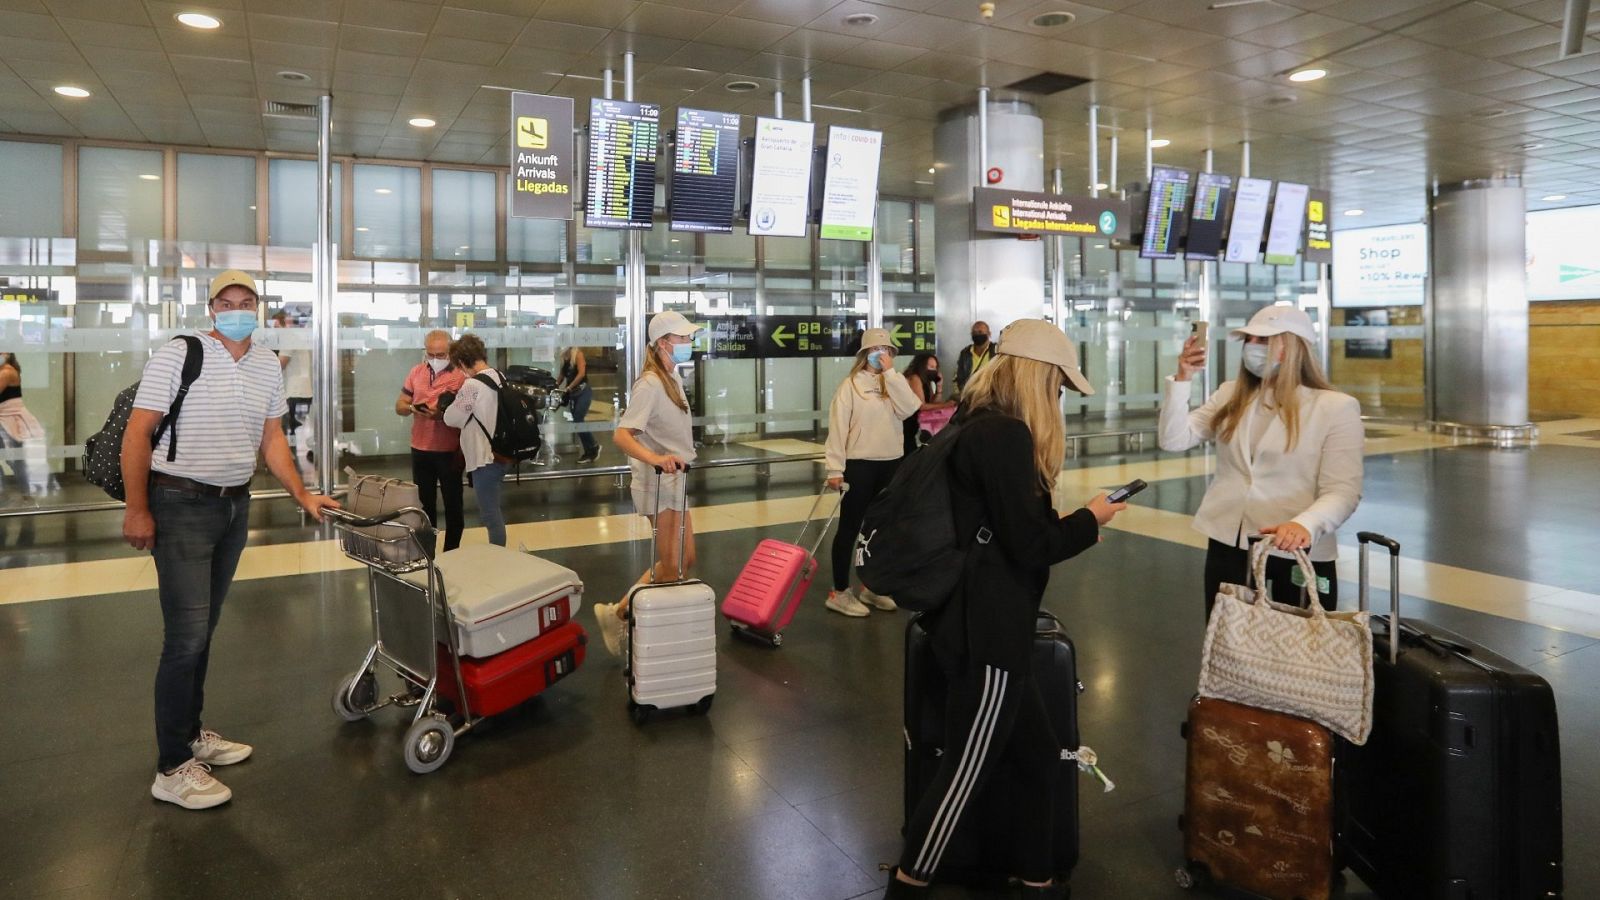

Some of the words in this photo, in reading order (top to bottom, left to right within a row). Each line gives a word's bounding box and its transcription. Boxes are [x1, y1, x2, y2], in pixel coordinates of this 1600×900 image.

[517, 152, 558, 166] Ankunft
[517, 166, 556, 180] Arrivals
[517, 179, 568, 194] Llegadas
[1012, 207, 1046, 220] International
[1013, 218, 1044, 230] Llegadas
[1045, 220, 1096, 232] Internacionales
[1103, 215, 1113, 230] 2
[1359, 247, 1401, 261] Shop
[716, 341, 747, 352] Salidas
[810, 342, 823, 351] Bus
